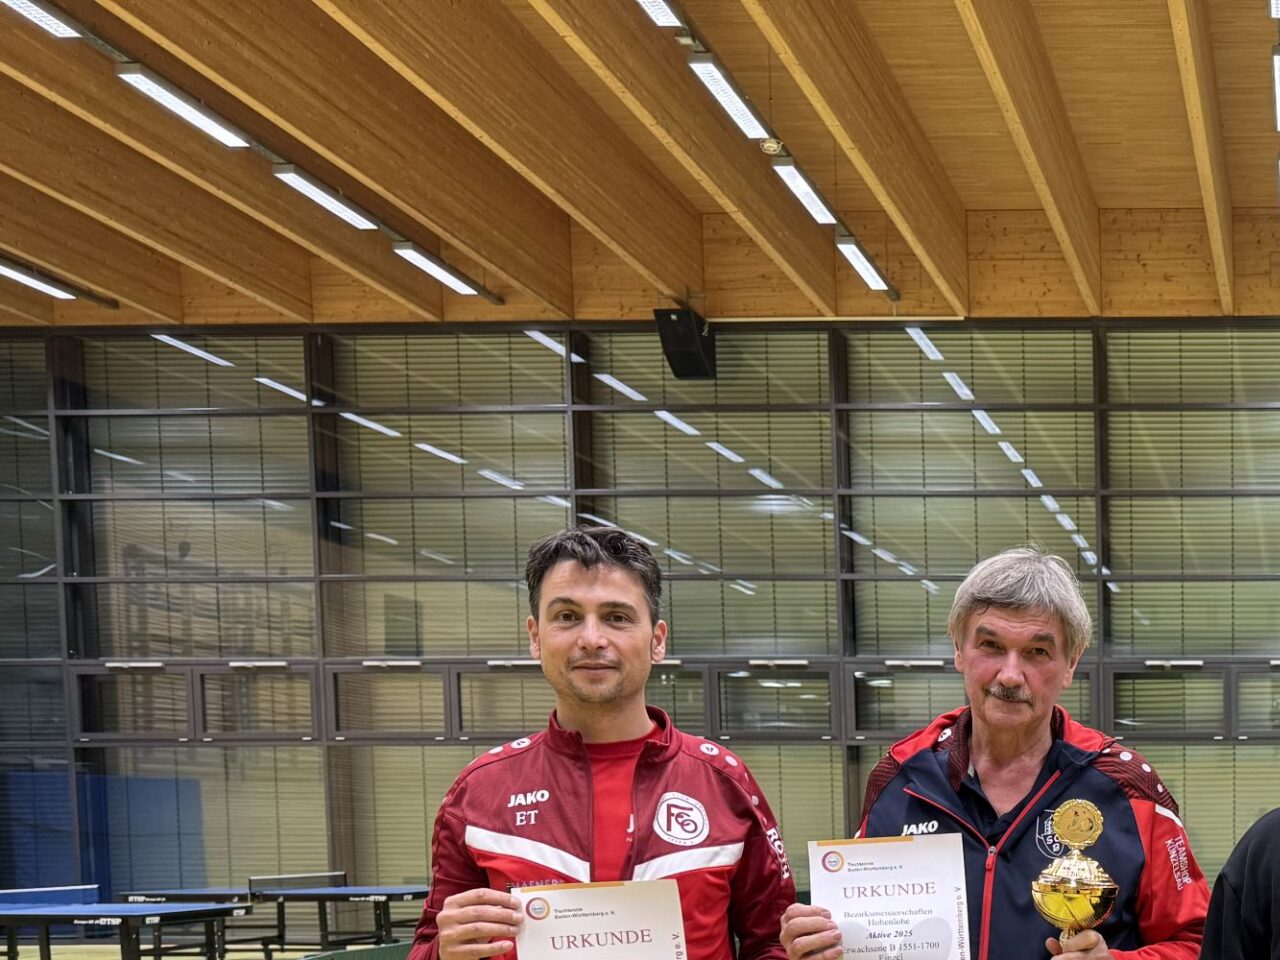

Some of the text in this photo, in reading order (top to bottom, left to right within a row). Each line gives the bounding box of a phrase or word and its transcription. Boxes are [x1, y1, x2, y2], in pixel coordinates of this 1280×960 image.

[507, 789, 550, 807] JAKO
[515, 809, 538, 827] ET
[901, 820, 939, 836] JAKO
[1175, 836, 1192, 884] TEAMSHOP
[843, 882, 936, 899] URKUNDE
[867, 917, 910, 927] Hohenlohe
[550, 928, 653, 951] URKUNDE
[865, 930, 913, 939] Aktive 2025
[889, 943, 896, 952] B
[899, 941, 940, 951] 1551-1700
